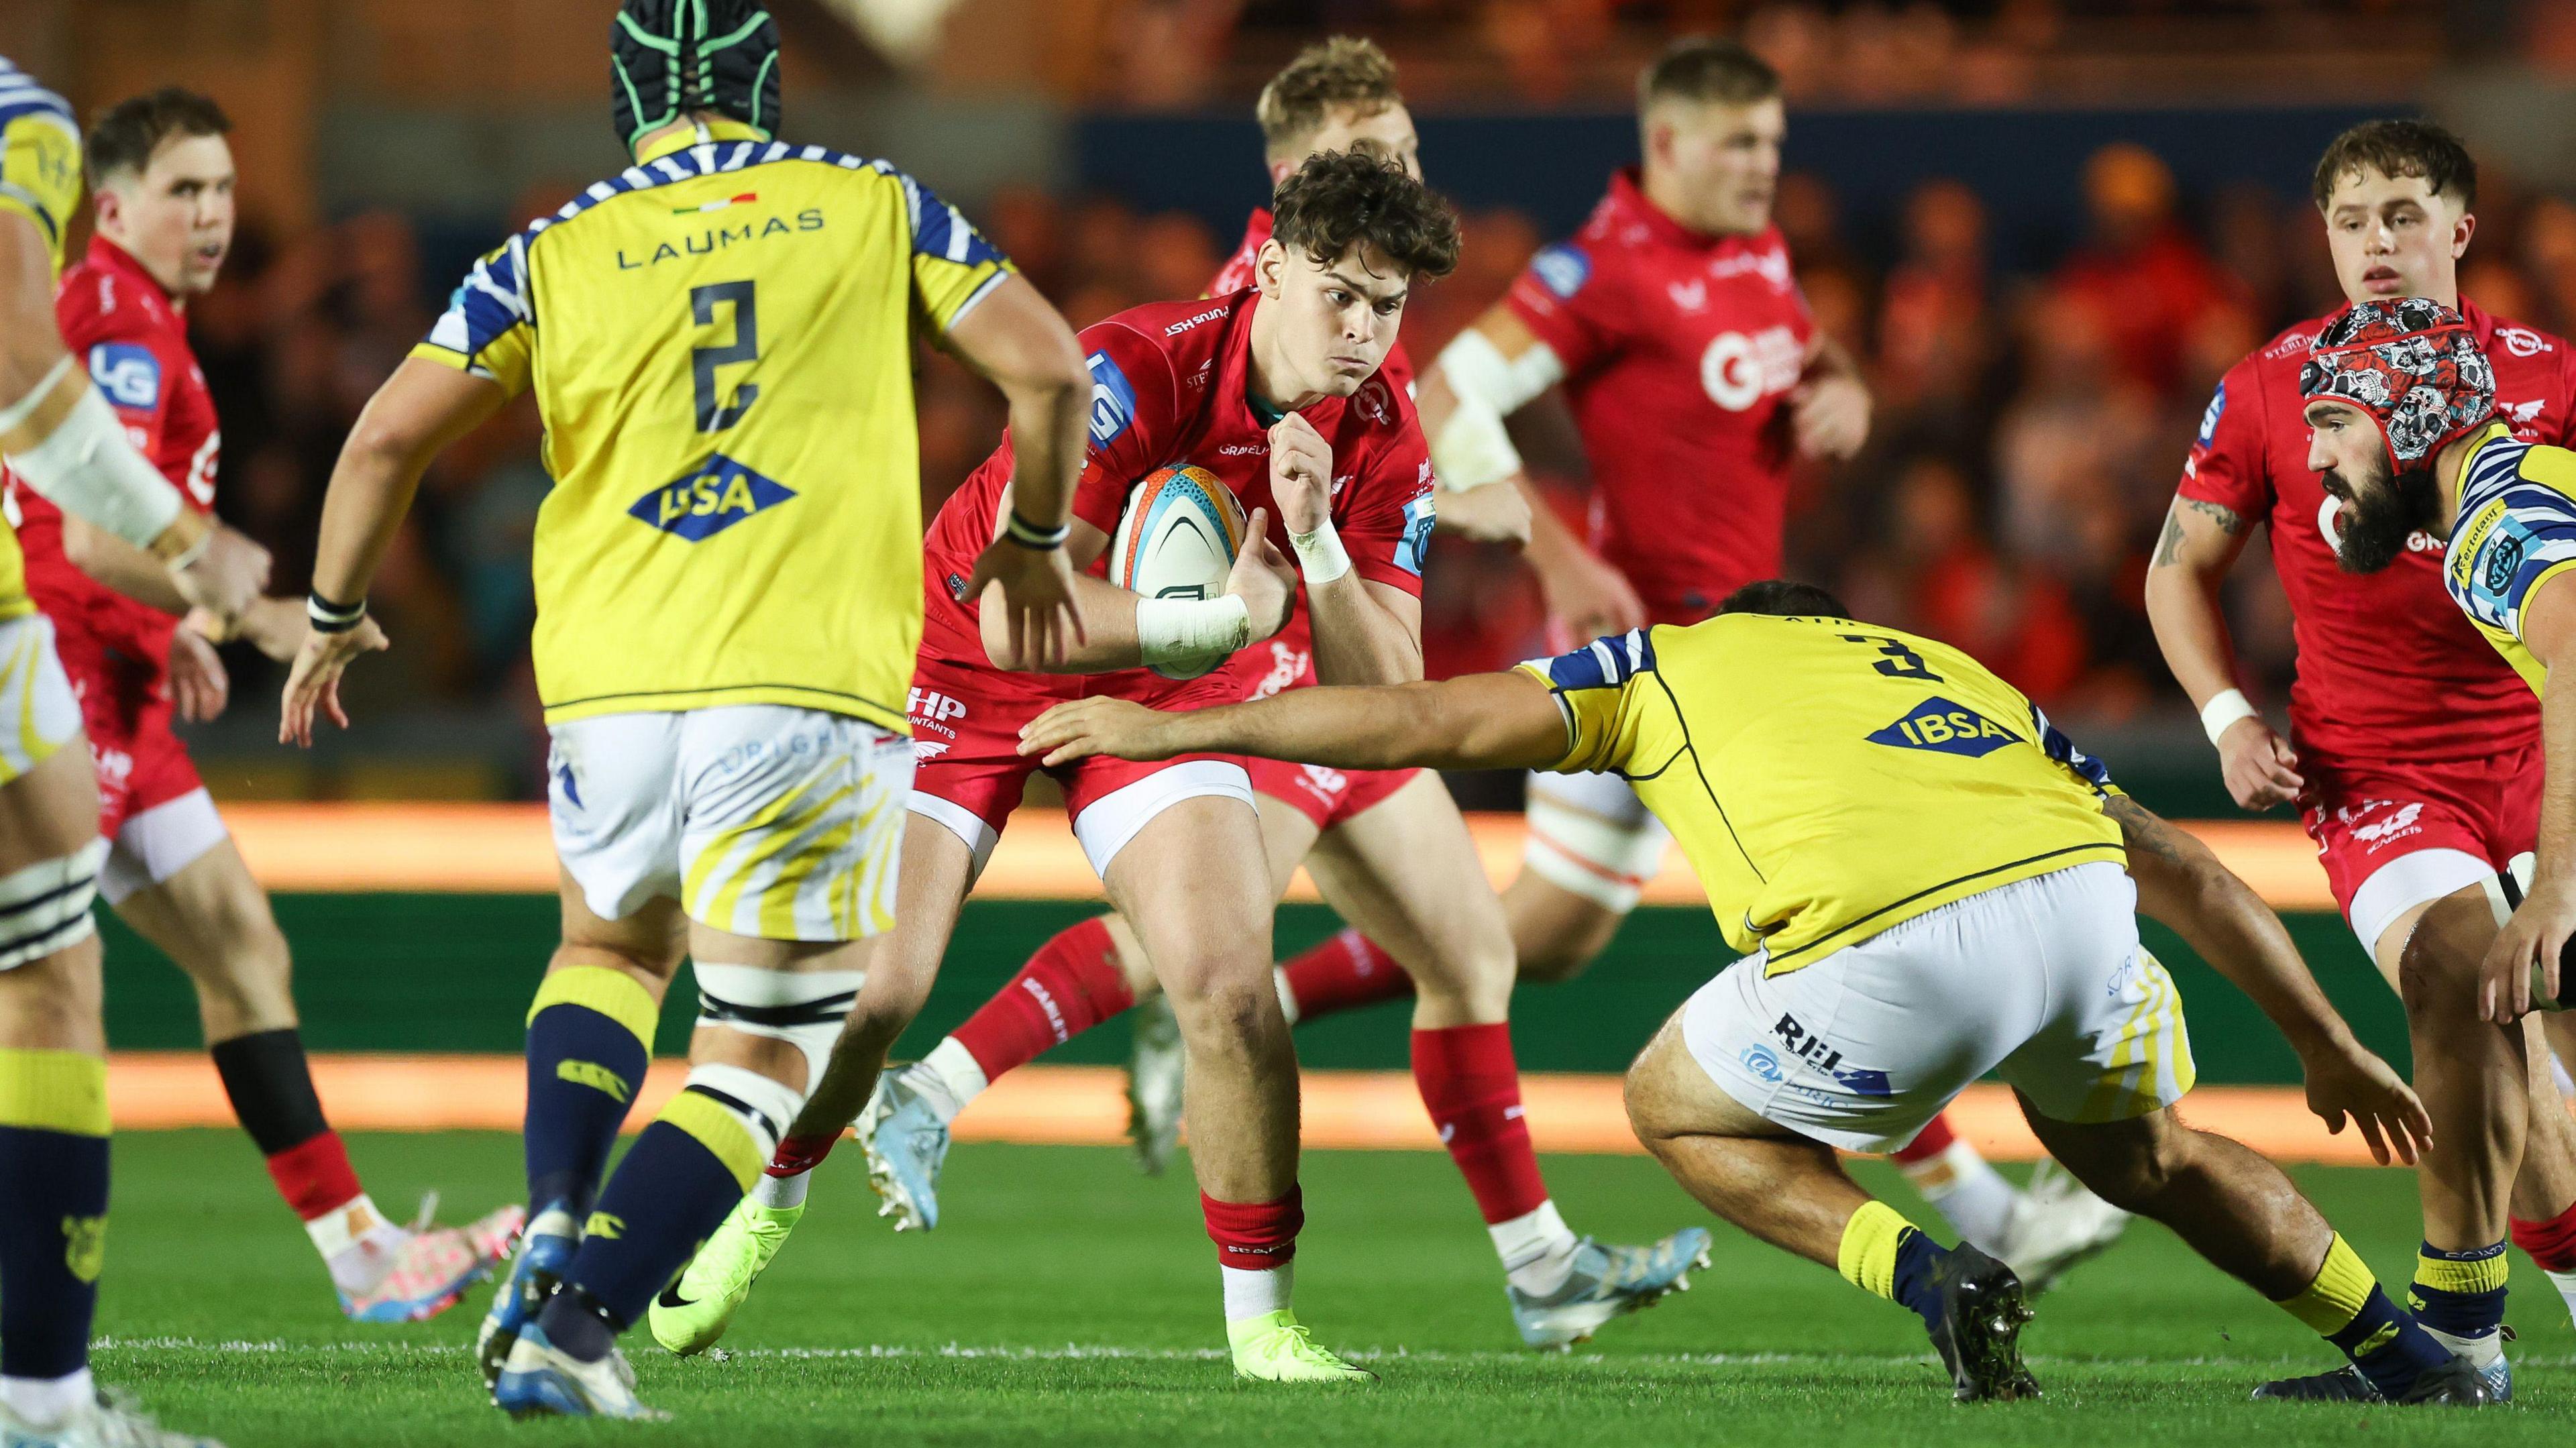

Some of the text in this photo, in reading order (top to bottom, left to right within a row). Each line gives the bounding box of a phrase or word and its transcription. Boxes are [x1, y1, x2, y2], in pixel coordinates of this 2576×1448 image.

[617, 209, 824, 270] LAUMAS
[689, 280, 759, 434] 2
[1835, 634, 1945, 683] 3
[1898, 712, 2013, 746] IBSA
